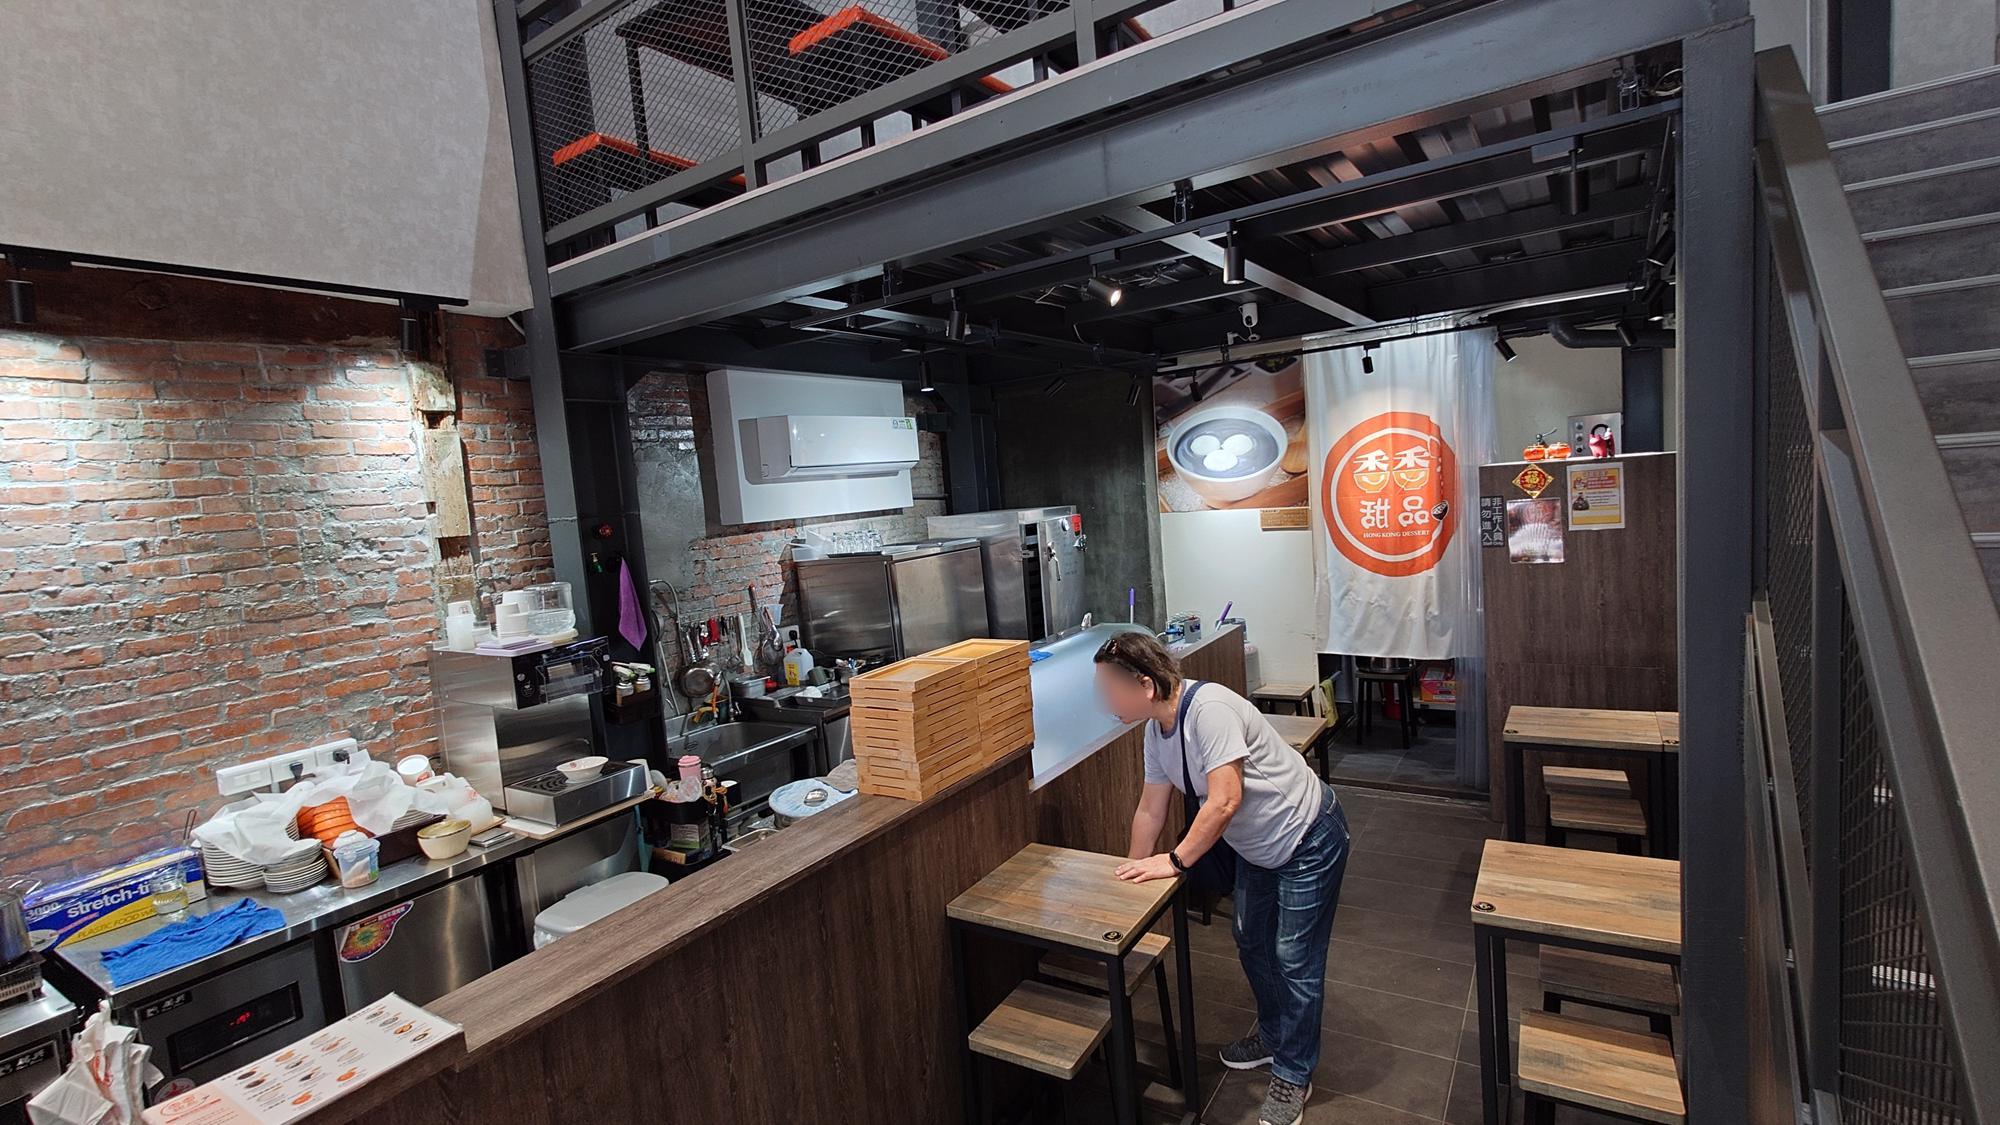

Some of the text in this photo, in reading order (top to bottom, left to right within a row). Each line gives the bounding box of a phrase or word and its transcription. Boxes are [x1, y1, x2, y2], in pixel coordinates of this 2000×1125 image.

[1353, 445, 1430, 493] 香香
[1359, 495, 1430, 529] 甜品
[1480, 497, 1492, 542] 請勿進入
[1491, 497, 1503, 541] 非工作人員
[1363, 531, 1381, 539] HONG
[1402, 529, 1429, 537] DESSERT
[66, 880, 151, 918] stretch-ti
[113, 912, 140, 927] FOOD
